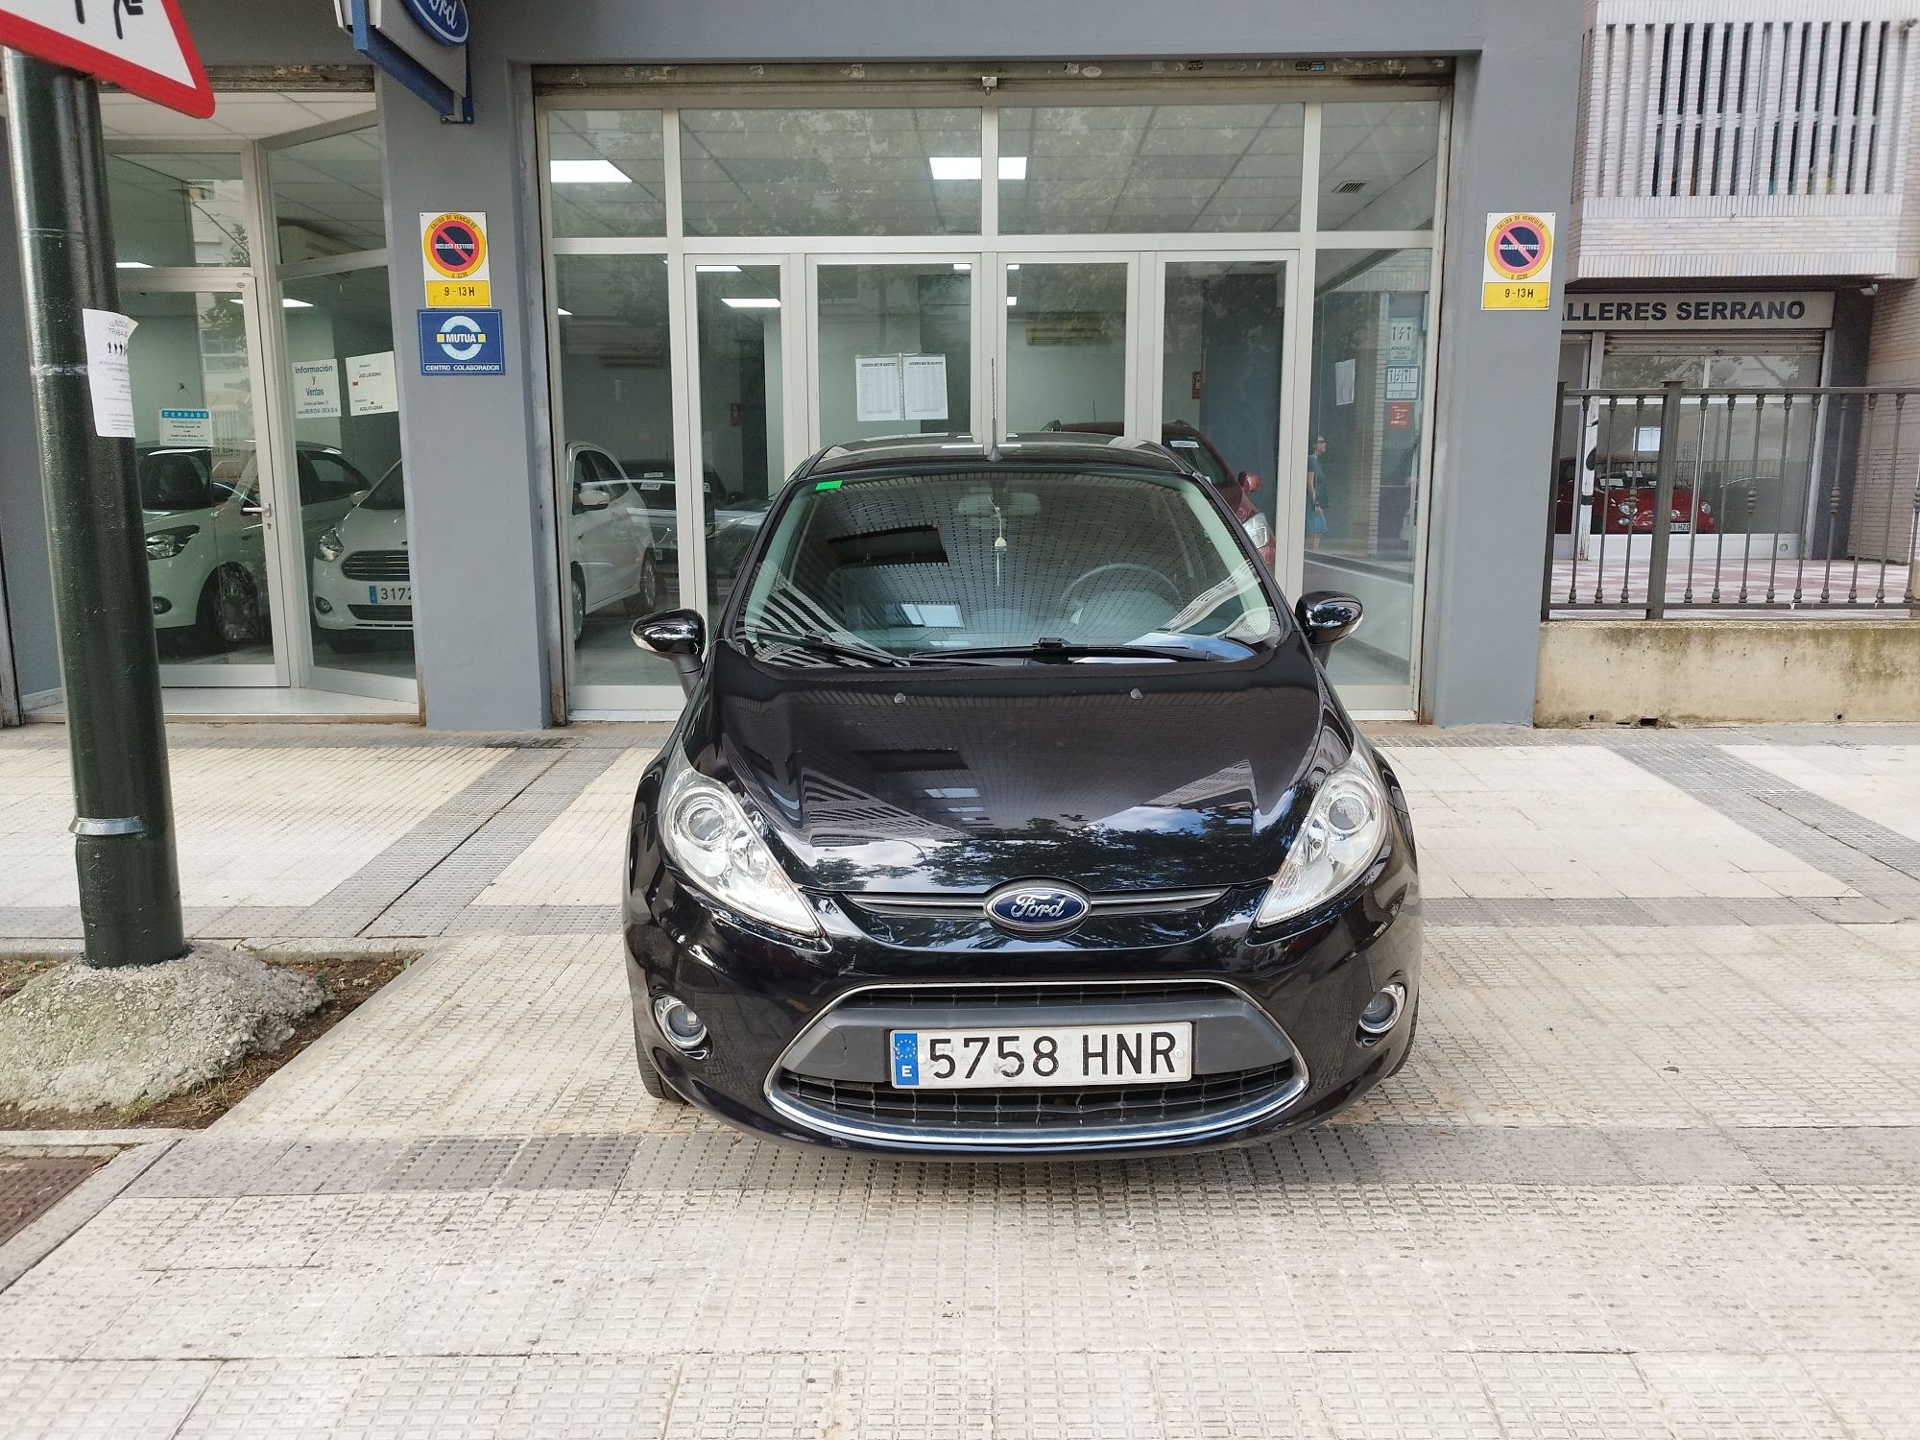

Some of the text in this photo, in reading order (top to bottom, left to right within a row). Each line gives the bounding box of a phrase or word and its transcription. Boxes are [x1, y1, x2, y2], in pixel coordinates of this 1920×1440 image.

[428, 0, 458, 29] ord
[1562, 300, 1806, 321] LLERES SERRANO
[445, 333, 477, 343] MUTUA
[294, 364, 333, 374] Información
[311, 376, 316, 386] y
[305, 387, 325, 397] Ventas
[1010, 893, 1066, 918] Ford
[929, 1031, 1177, 1079] 5758 HNR
[901, 1065, 913, 1078] E
